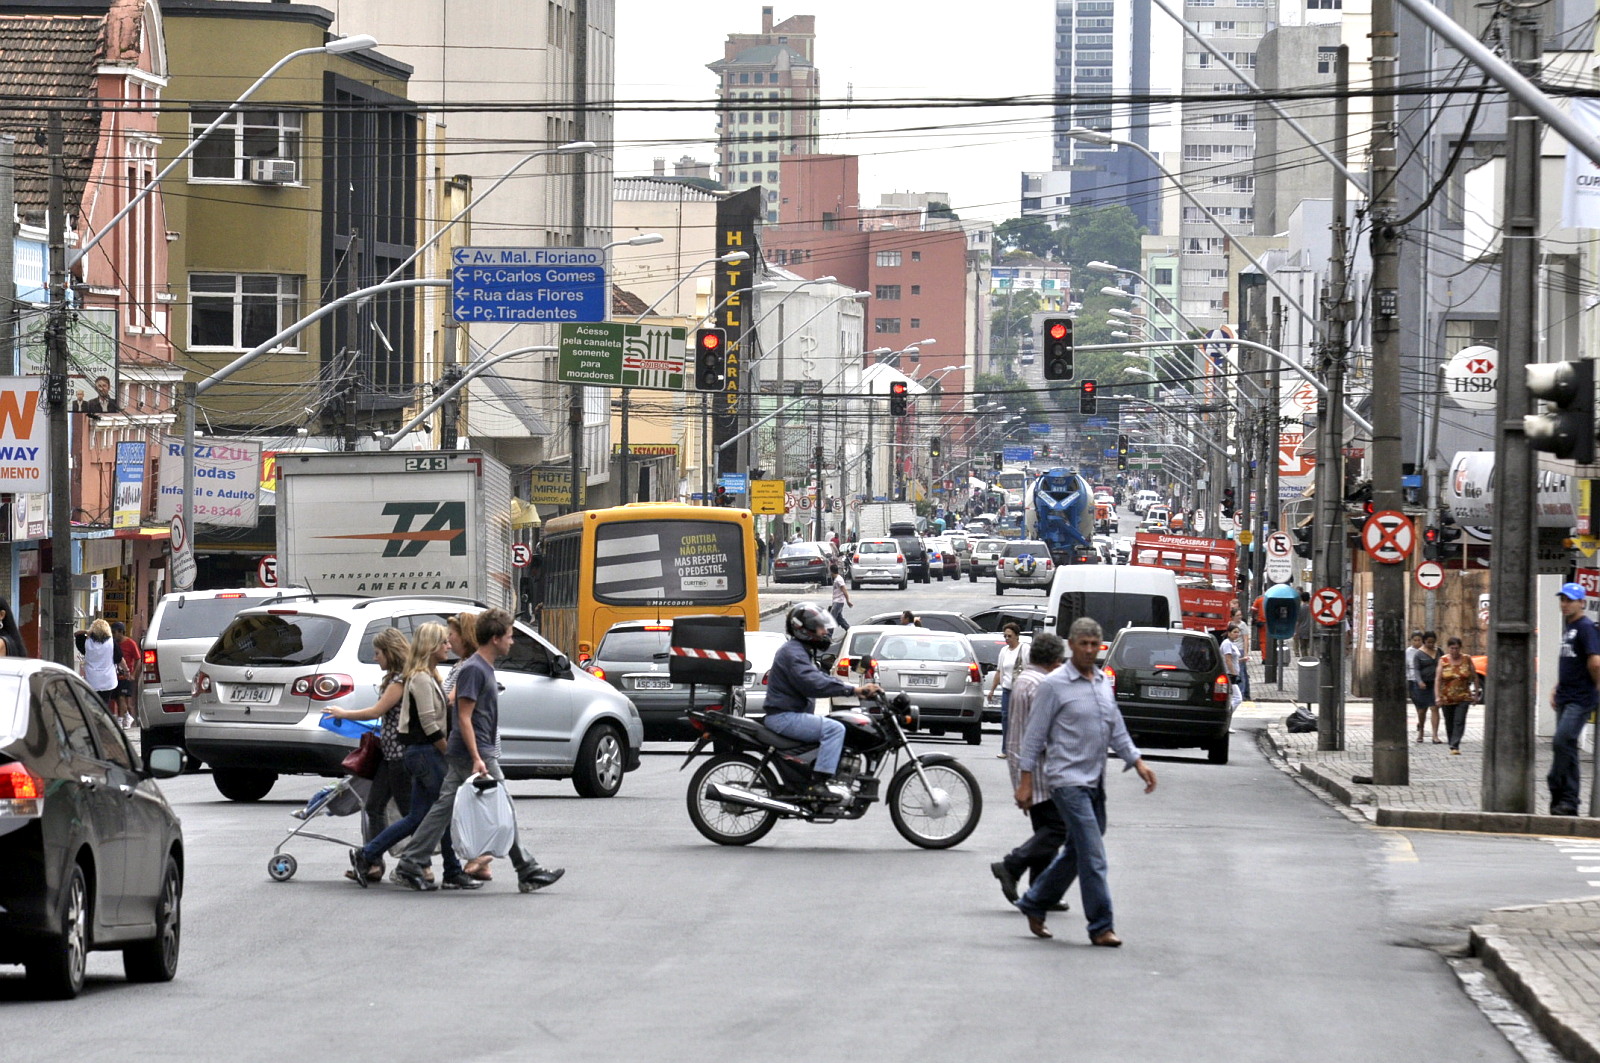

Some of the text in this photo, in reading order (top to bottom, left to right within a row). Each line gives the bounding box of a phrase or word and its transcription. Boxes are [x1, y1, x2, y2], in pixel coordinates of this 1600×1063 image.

[473, 250, 597, 264] Av. Mal. Floriano
[545, 269, 596, 283] Gomes
[473, 288, 584, 302] Rua das Flores
[576, 326, 609, 336] Acesso
[562, 337, 622, 349] pela canaleta
[572, 348, 610, 358] somente
[580, 360, 601, 369] para
[566, 369, 615, 380] moradores
[406, 458, 447, 470] 243
[537, 471, 571, 483] HOTE
[217, 488, 256, 500] Adulto
[381, 501, 467, 558] TA
[681, 533, 717, 545] CURITIBA
[679, 543, 721, 556] NÃO PARA.
[674, 553, 728, 568] MAS RESPEITA
[322, 571, 442, 580] TRANSPORTADORA
[678, 564, 726, 577] O PEDESTRE.
[357, 580, 469, 592] AMERICANA
